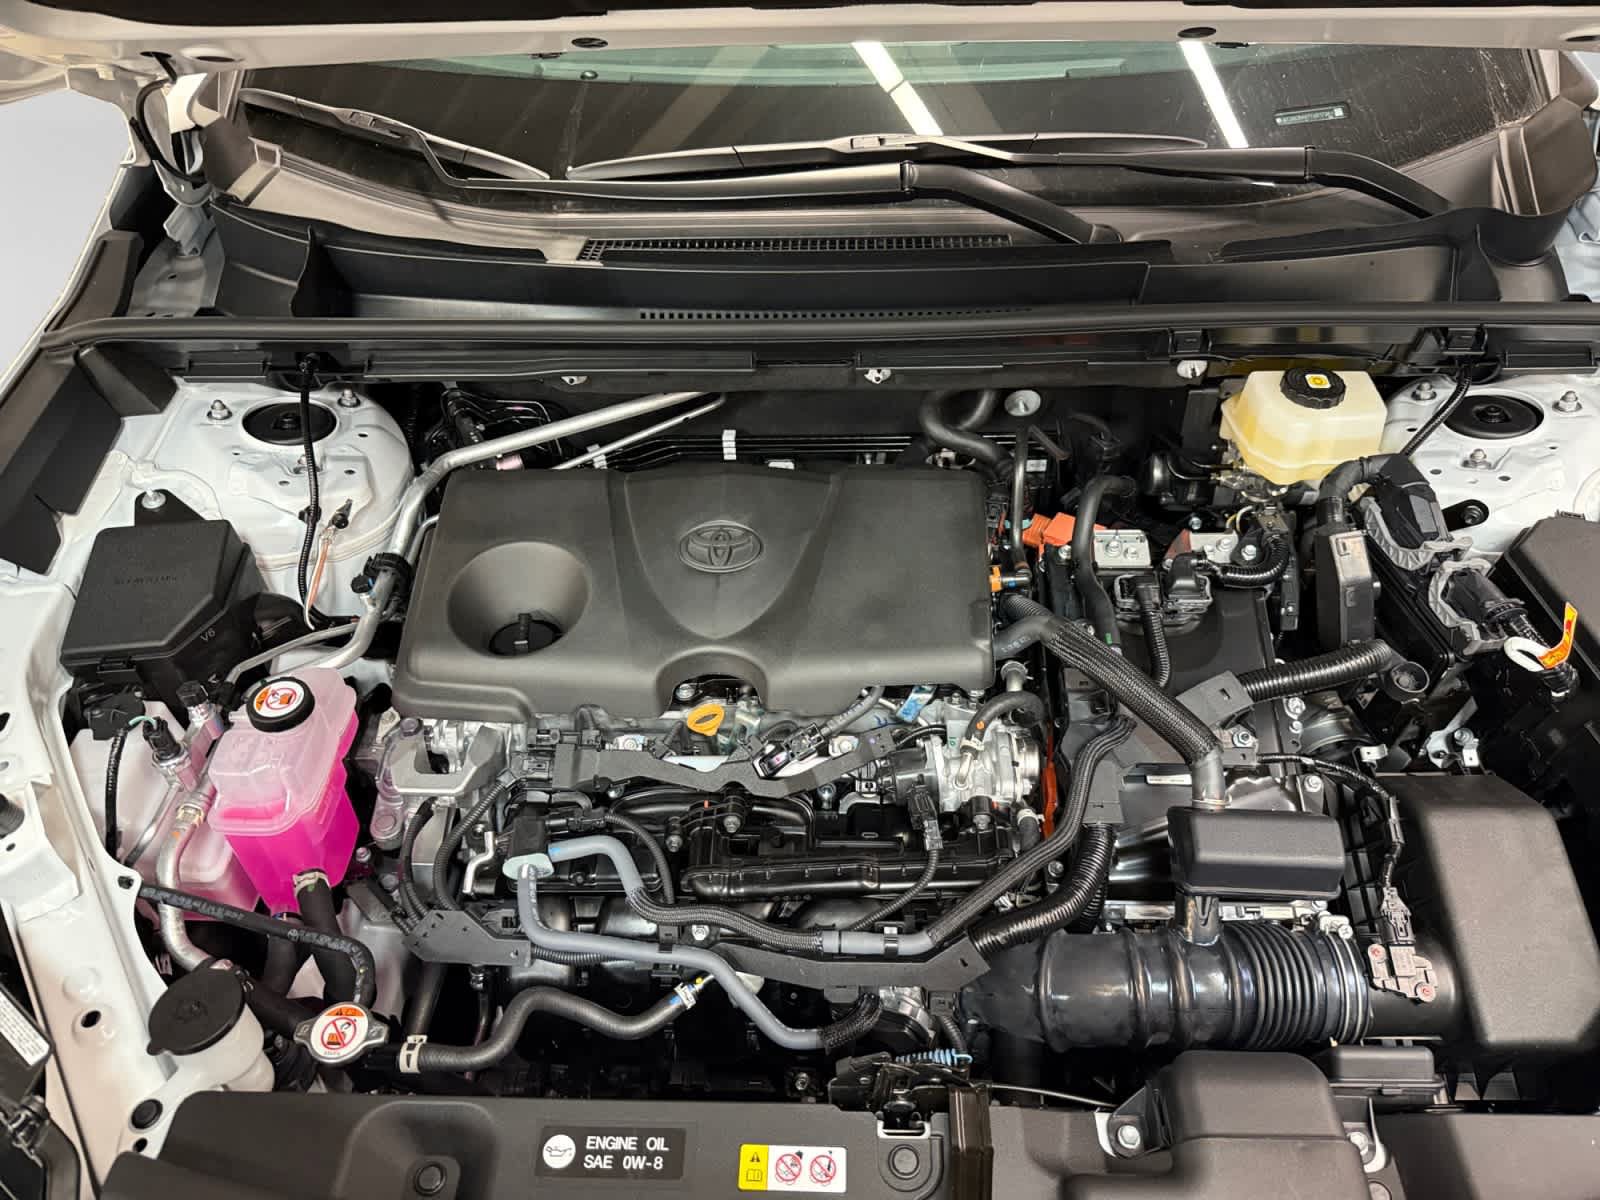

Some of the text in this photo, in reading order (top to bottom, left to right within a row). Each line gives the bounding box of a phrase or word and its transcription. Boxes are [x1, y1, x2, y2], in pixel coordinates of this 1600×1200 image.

[586, 1135, 669, 1151] ENGINE OIL
[584, 1154, 664, 1170] SAE 0W-8
